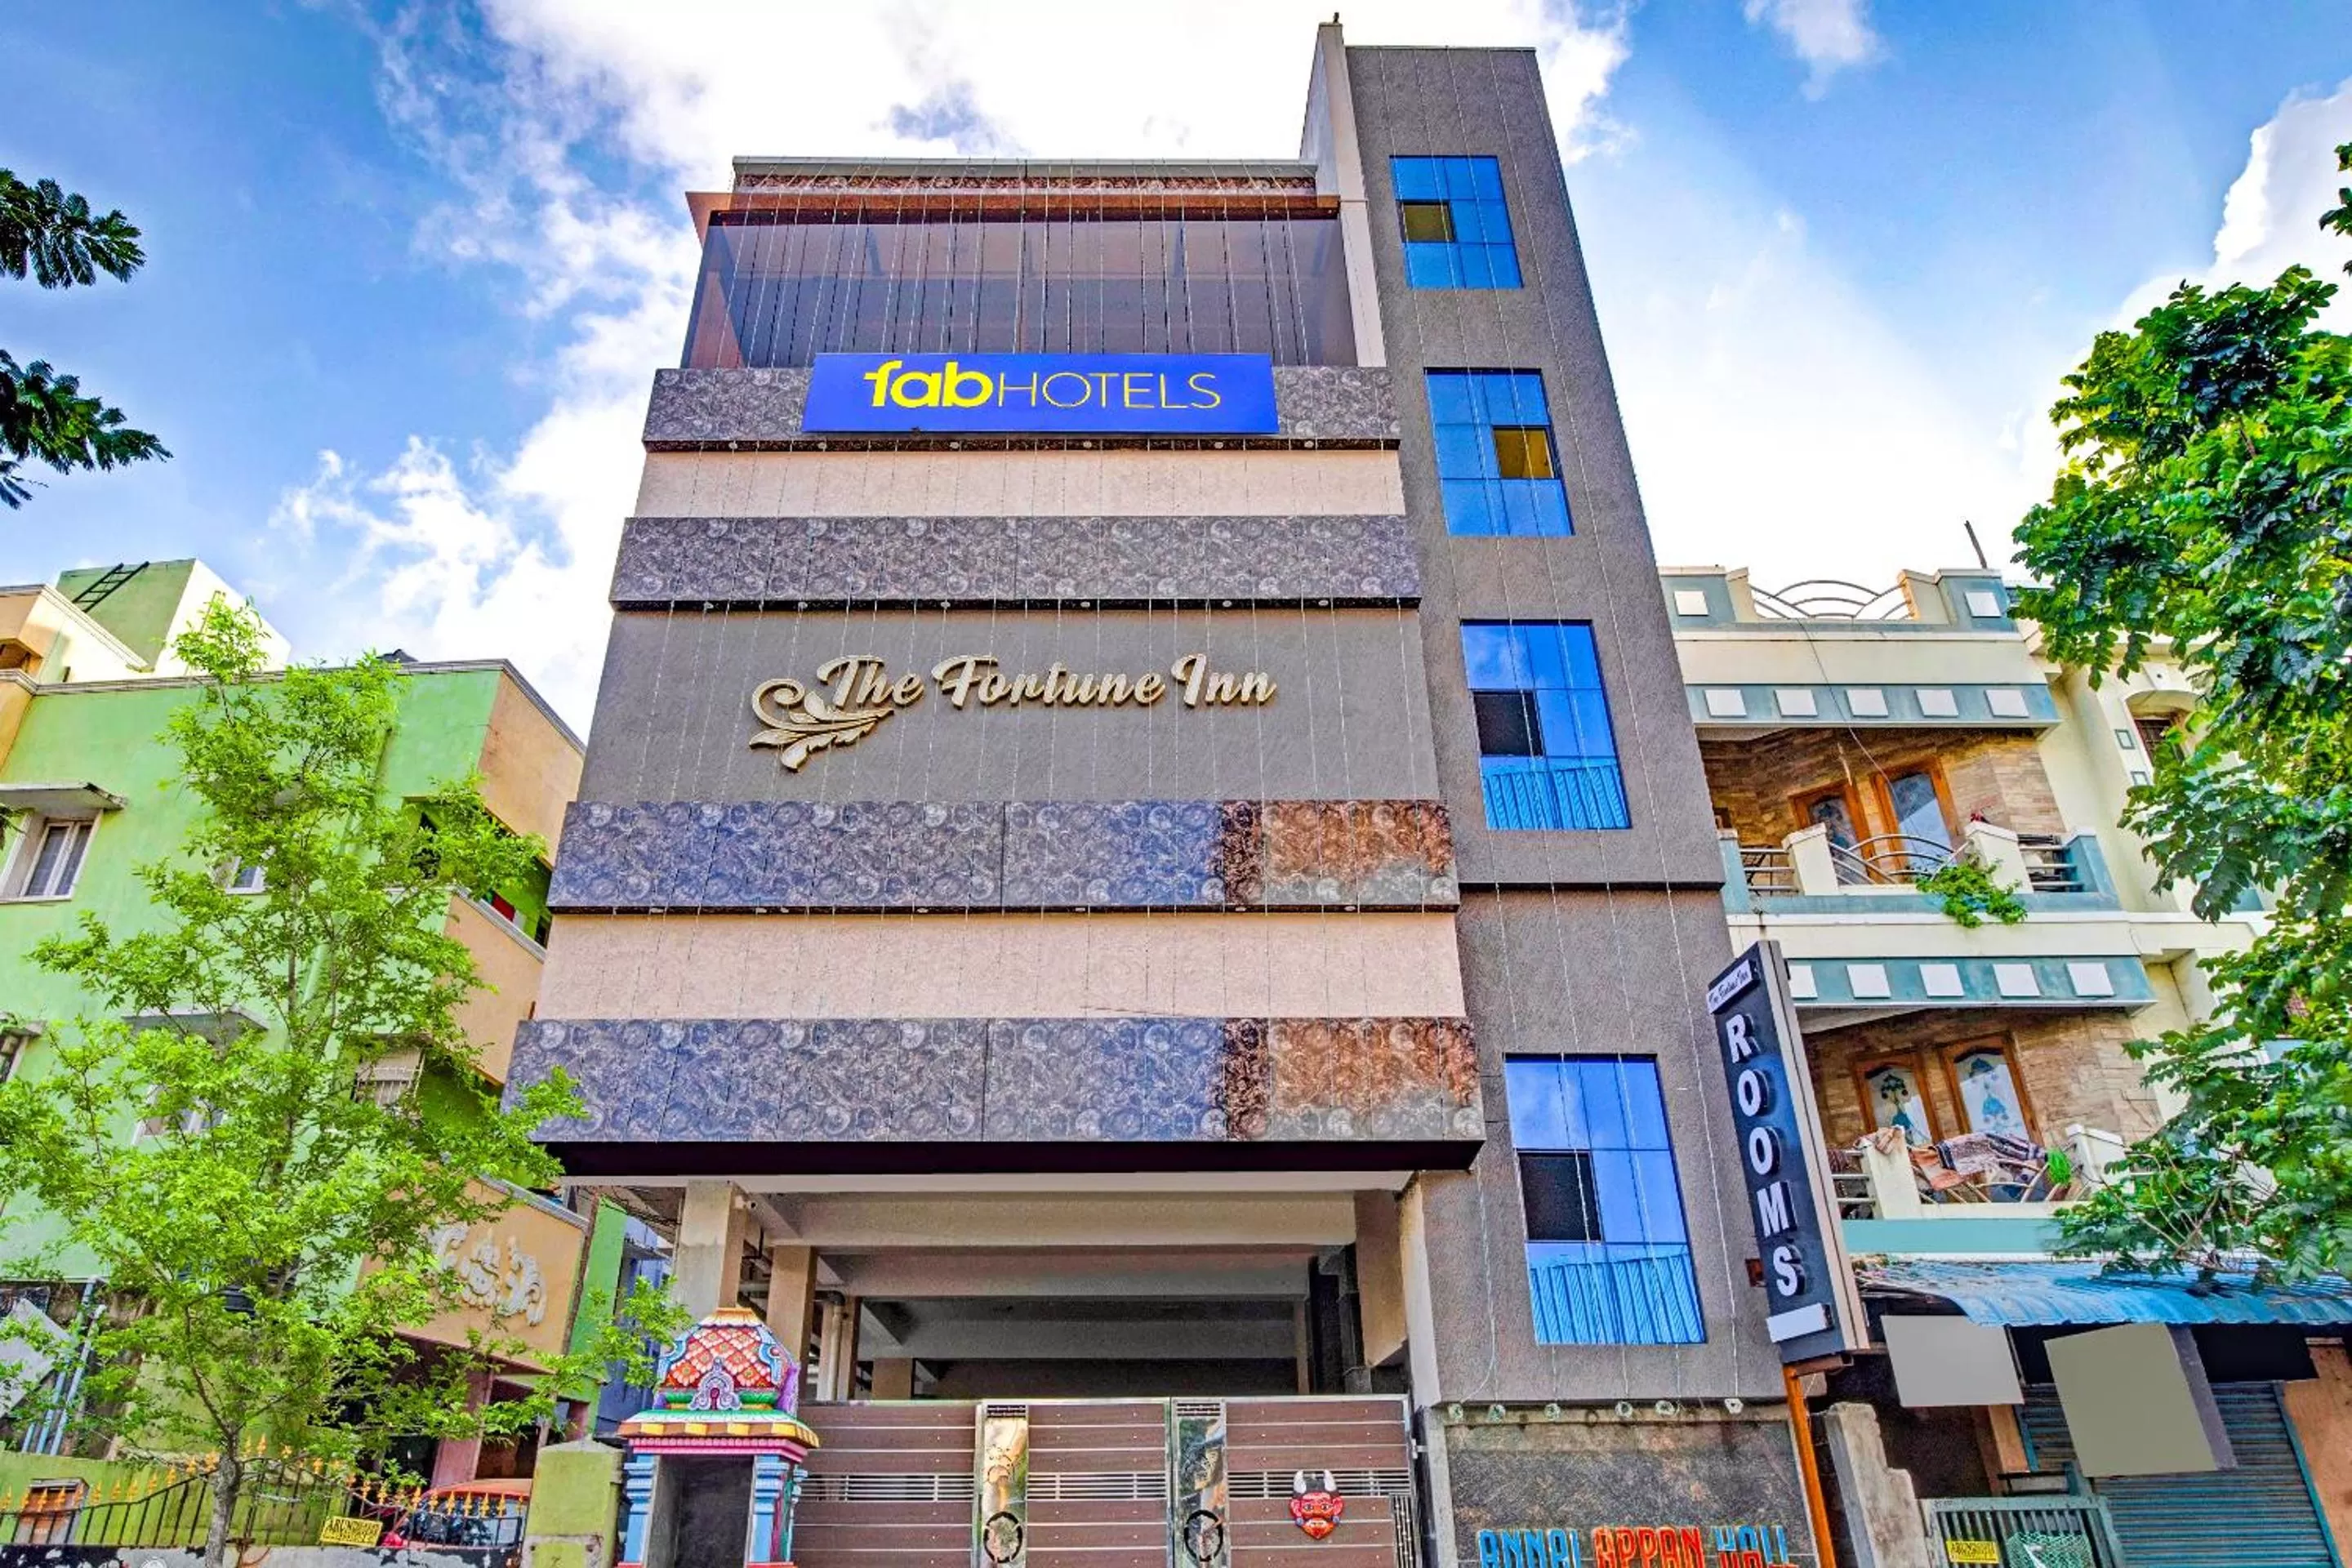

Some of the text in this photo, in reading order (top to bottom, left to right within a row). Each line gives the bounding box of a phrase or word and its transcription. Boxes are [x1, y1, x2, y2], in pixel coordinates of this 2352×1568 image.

[817, 653, 1277, 709] The Fortune Inn
[1726, 1013, 1802, 1297] ROOMS
